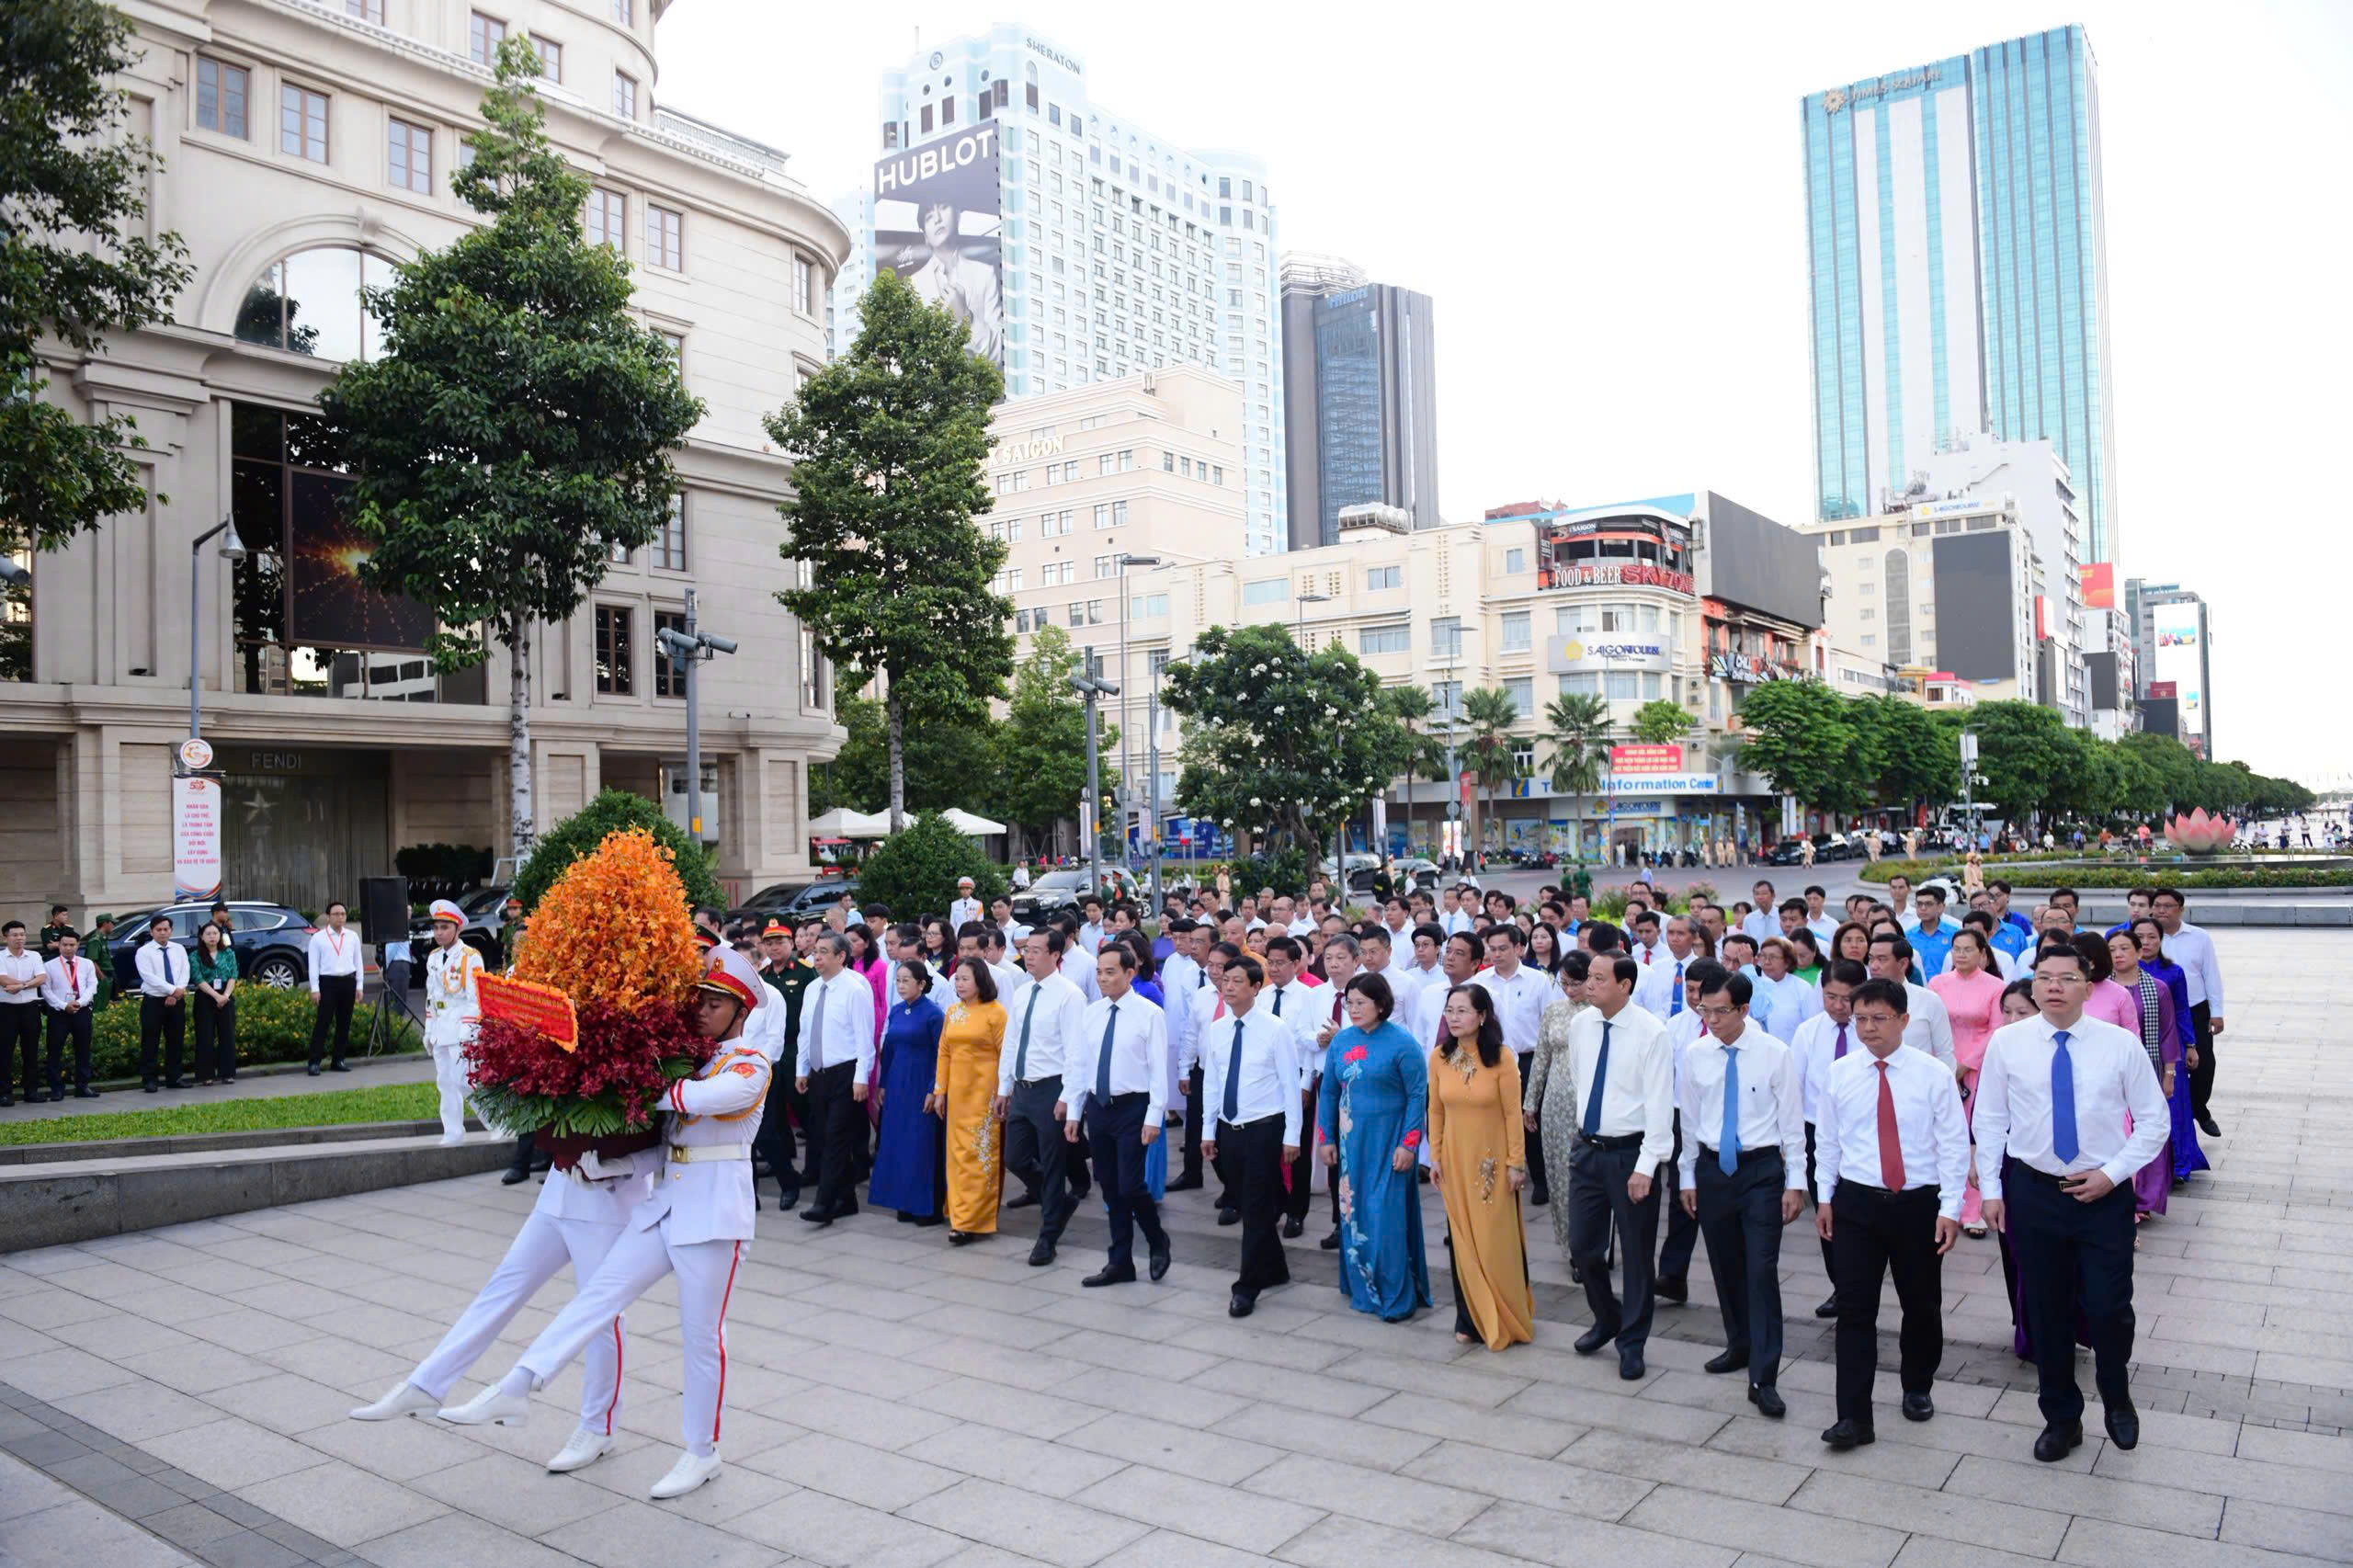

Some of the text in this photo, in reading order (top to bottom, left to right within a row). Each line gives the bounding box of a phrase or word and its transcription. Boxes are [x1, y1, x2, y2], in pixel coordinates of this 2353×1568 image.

[1026, 37, 1081, 74] SHERATON
[878, 129, 994, 194] HUBLOT
[1002, 434, 1064, 464] SAIGON
[1554, 564, 1695, 595] FOOD & BEER SKY ZONE
[251, 752, 301, 769] FENDI
[1602, 778, 1686, 791] Information
